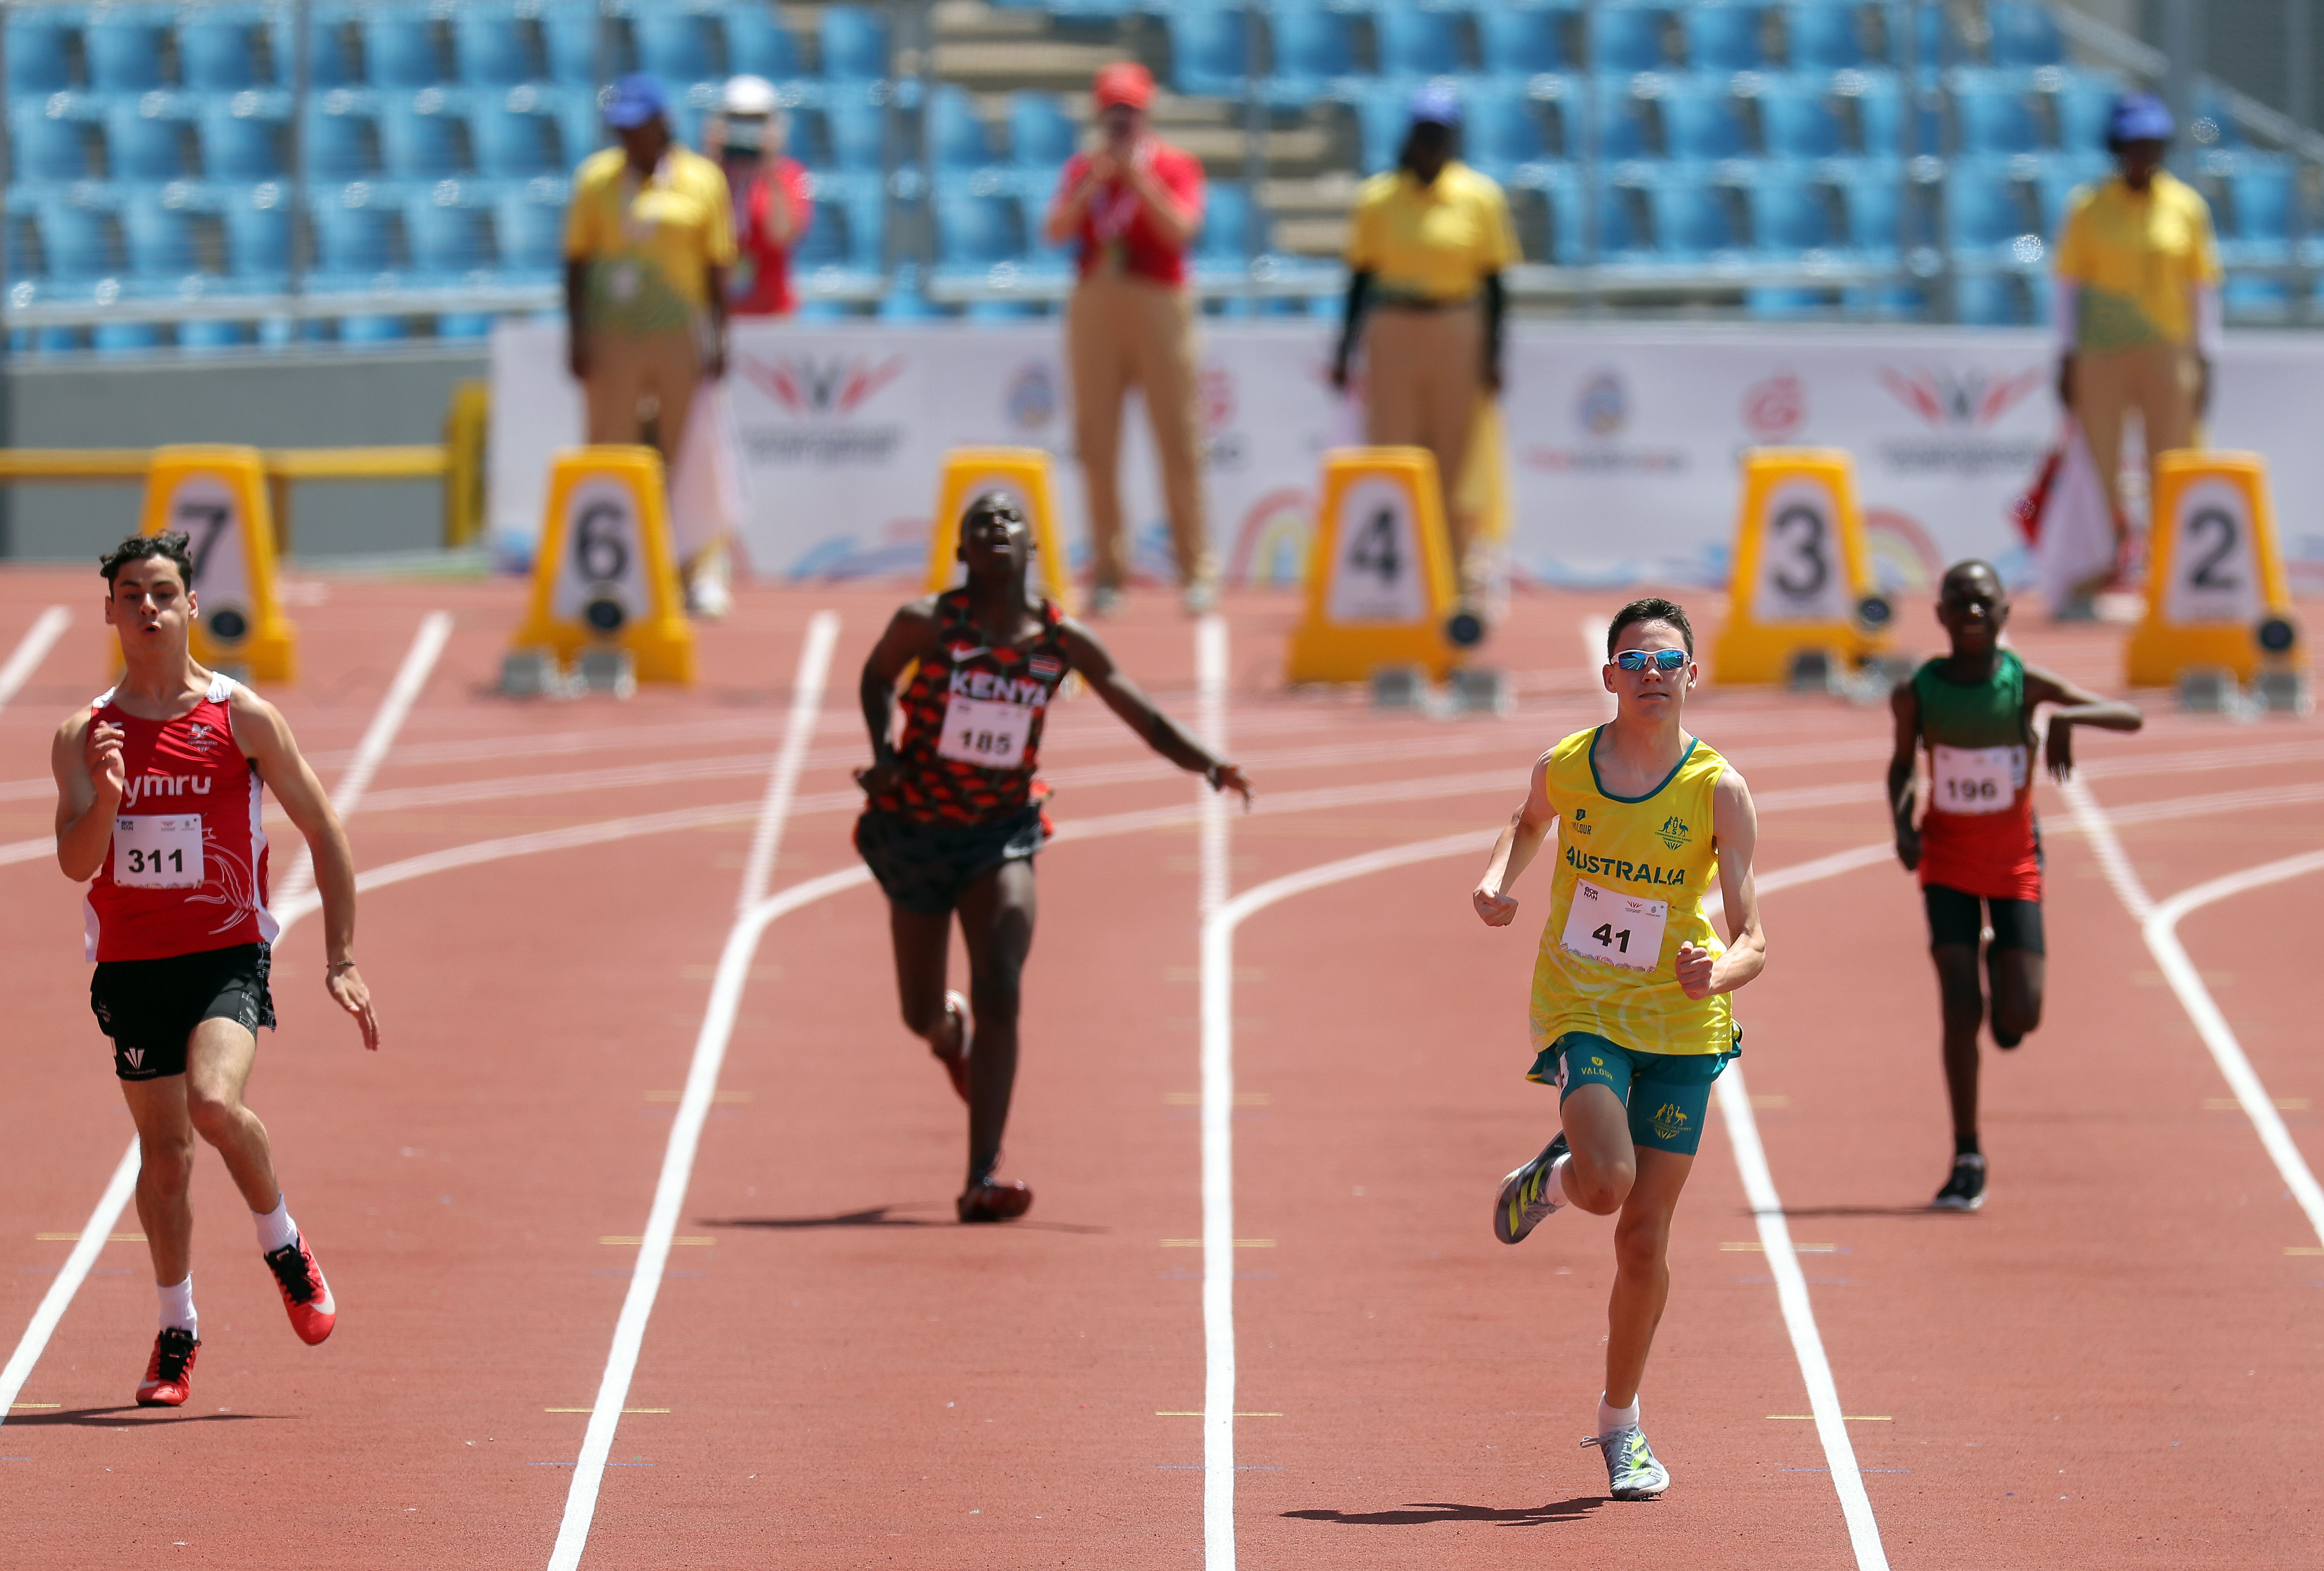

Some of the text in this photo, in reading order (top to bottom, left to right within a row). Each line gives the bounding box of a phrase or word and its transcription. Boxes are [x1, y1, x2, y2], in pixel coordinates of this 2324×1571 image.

[182, 505, 229, 584] 7
[575, 502, 629, 584] 6
[1348, 506, 1403, 584] 4
[1774, 505, 1827, 598] 3
[2188, 507, 2238, 589] 2
[950, 670, 1047, 707] KENYA
[961, 730, 1011, 755] 185
[123, 775, 212, 808] ymru
[1947, 778, 1996, 801] 196
[128, 849, 182, 873] 311
[1566, 845, 1685, 885] AUSTRALIA
[1584, 886, 1598, 895] BOR
[1584, 891, 1598, 901] NAN
[1592, 923, 1630, 953] 41
[1581, 1067, 1613, 1081] VALOUR
